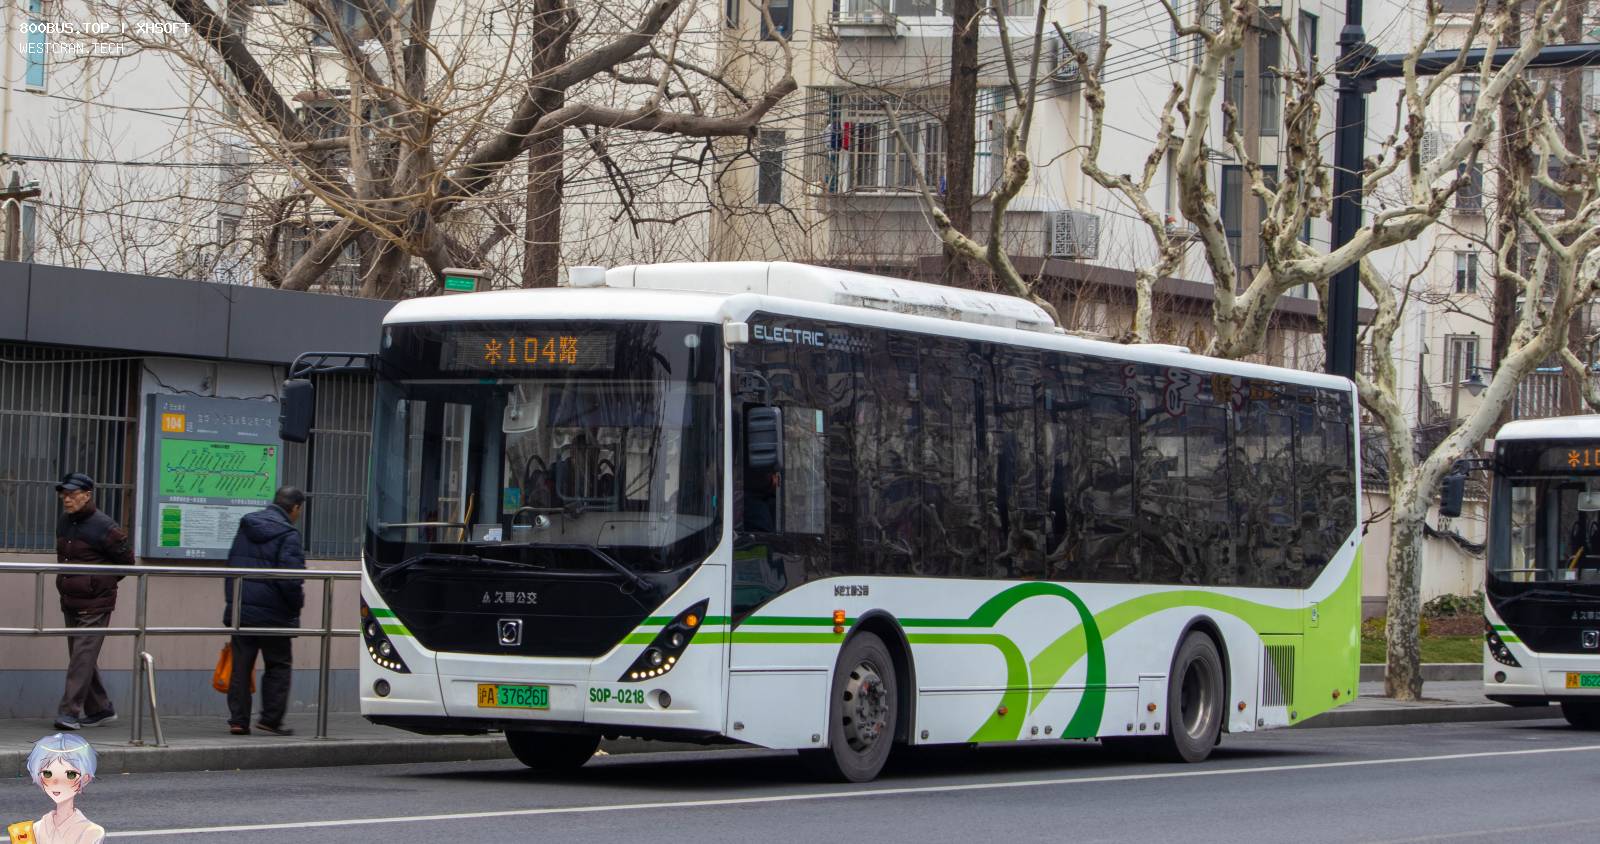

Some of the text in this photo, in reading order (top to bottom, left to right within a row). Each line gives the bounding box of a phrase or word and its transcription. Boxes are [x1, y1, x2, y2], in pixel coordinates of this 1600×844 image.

[754, 324, 824, 347] ELECTRIC
[166, 415, 181, 430] 104
[501, 686, 549, 708] 37626D
